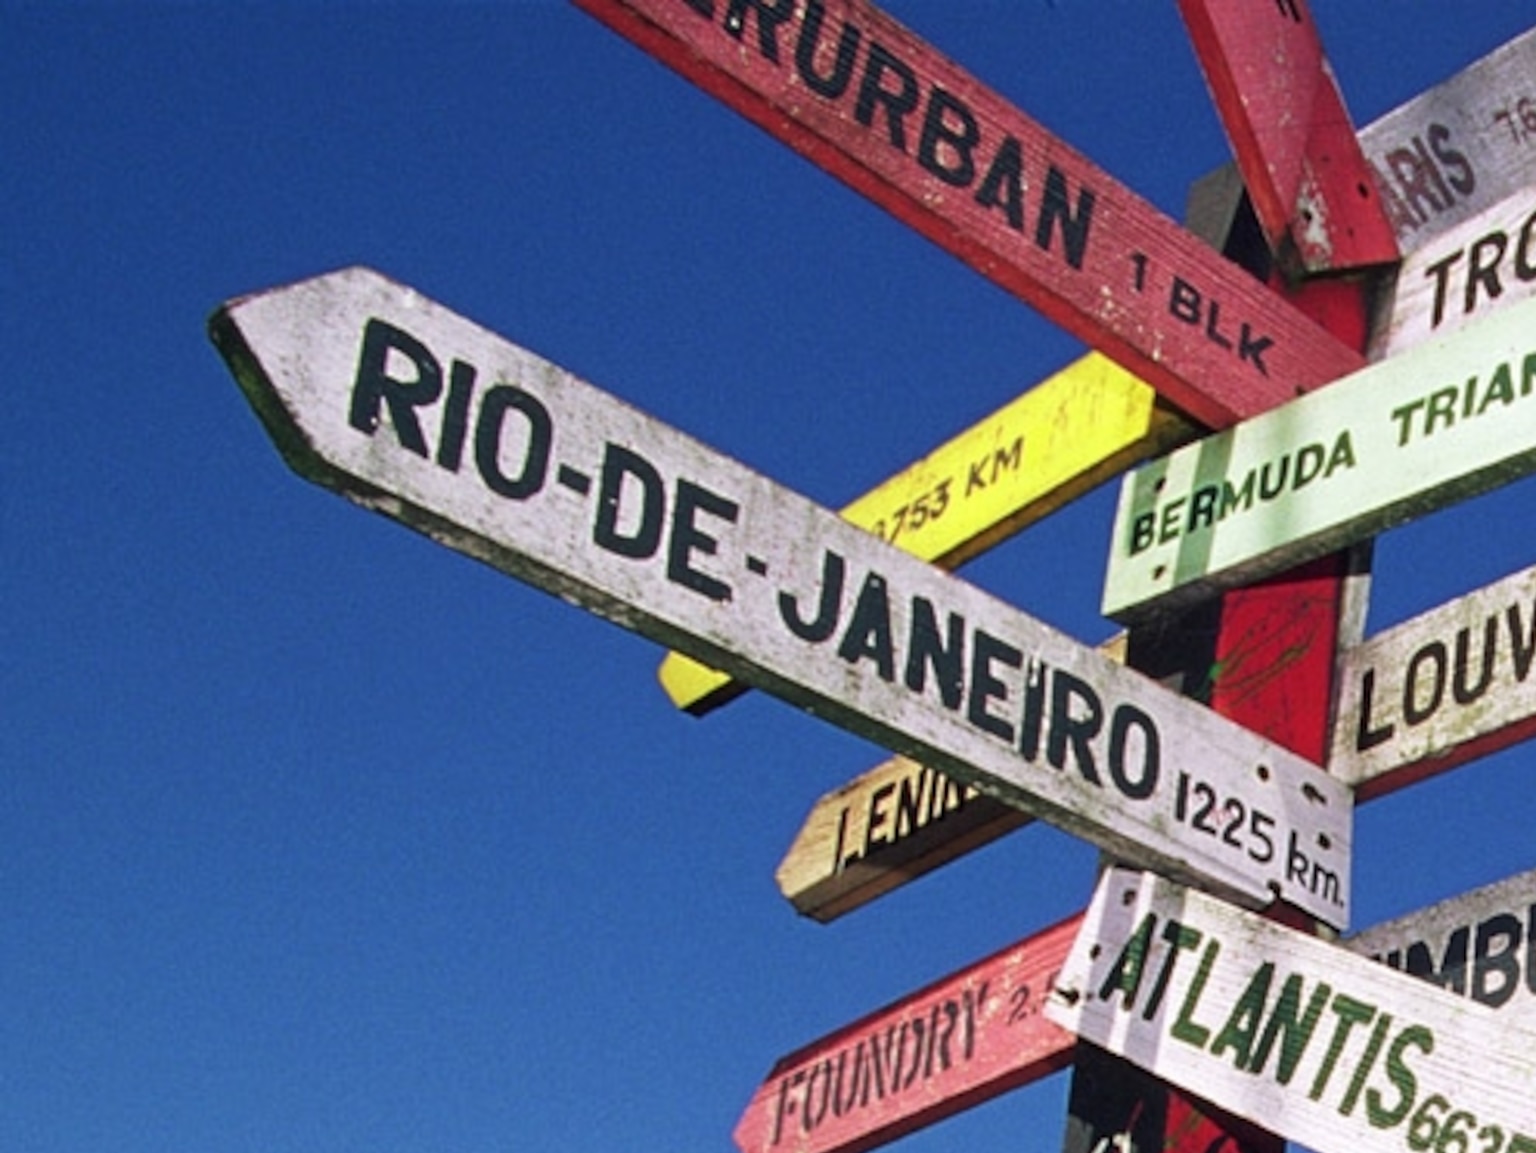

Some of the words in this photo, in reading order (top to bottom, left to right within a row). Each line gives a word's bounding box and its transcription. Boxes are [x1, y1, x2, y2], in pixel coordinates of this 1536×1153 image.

[684, 0, 1096, 270] RURBAN
[1130, 252, 1147, 292] 1
[1169, 277, 1276, 377] BLK
[965, 436, 1024, 498] KM
[1129, 430, 1356, 554] BERMUDA
[1175, 771, 1276, 863] 1225
[771, 983, 989, 1146] FOUNDRY
[1098, 912, 1435, 1128] ATLANTIS
